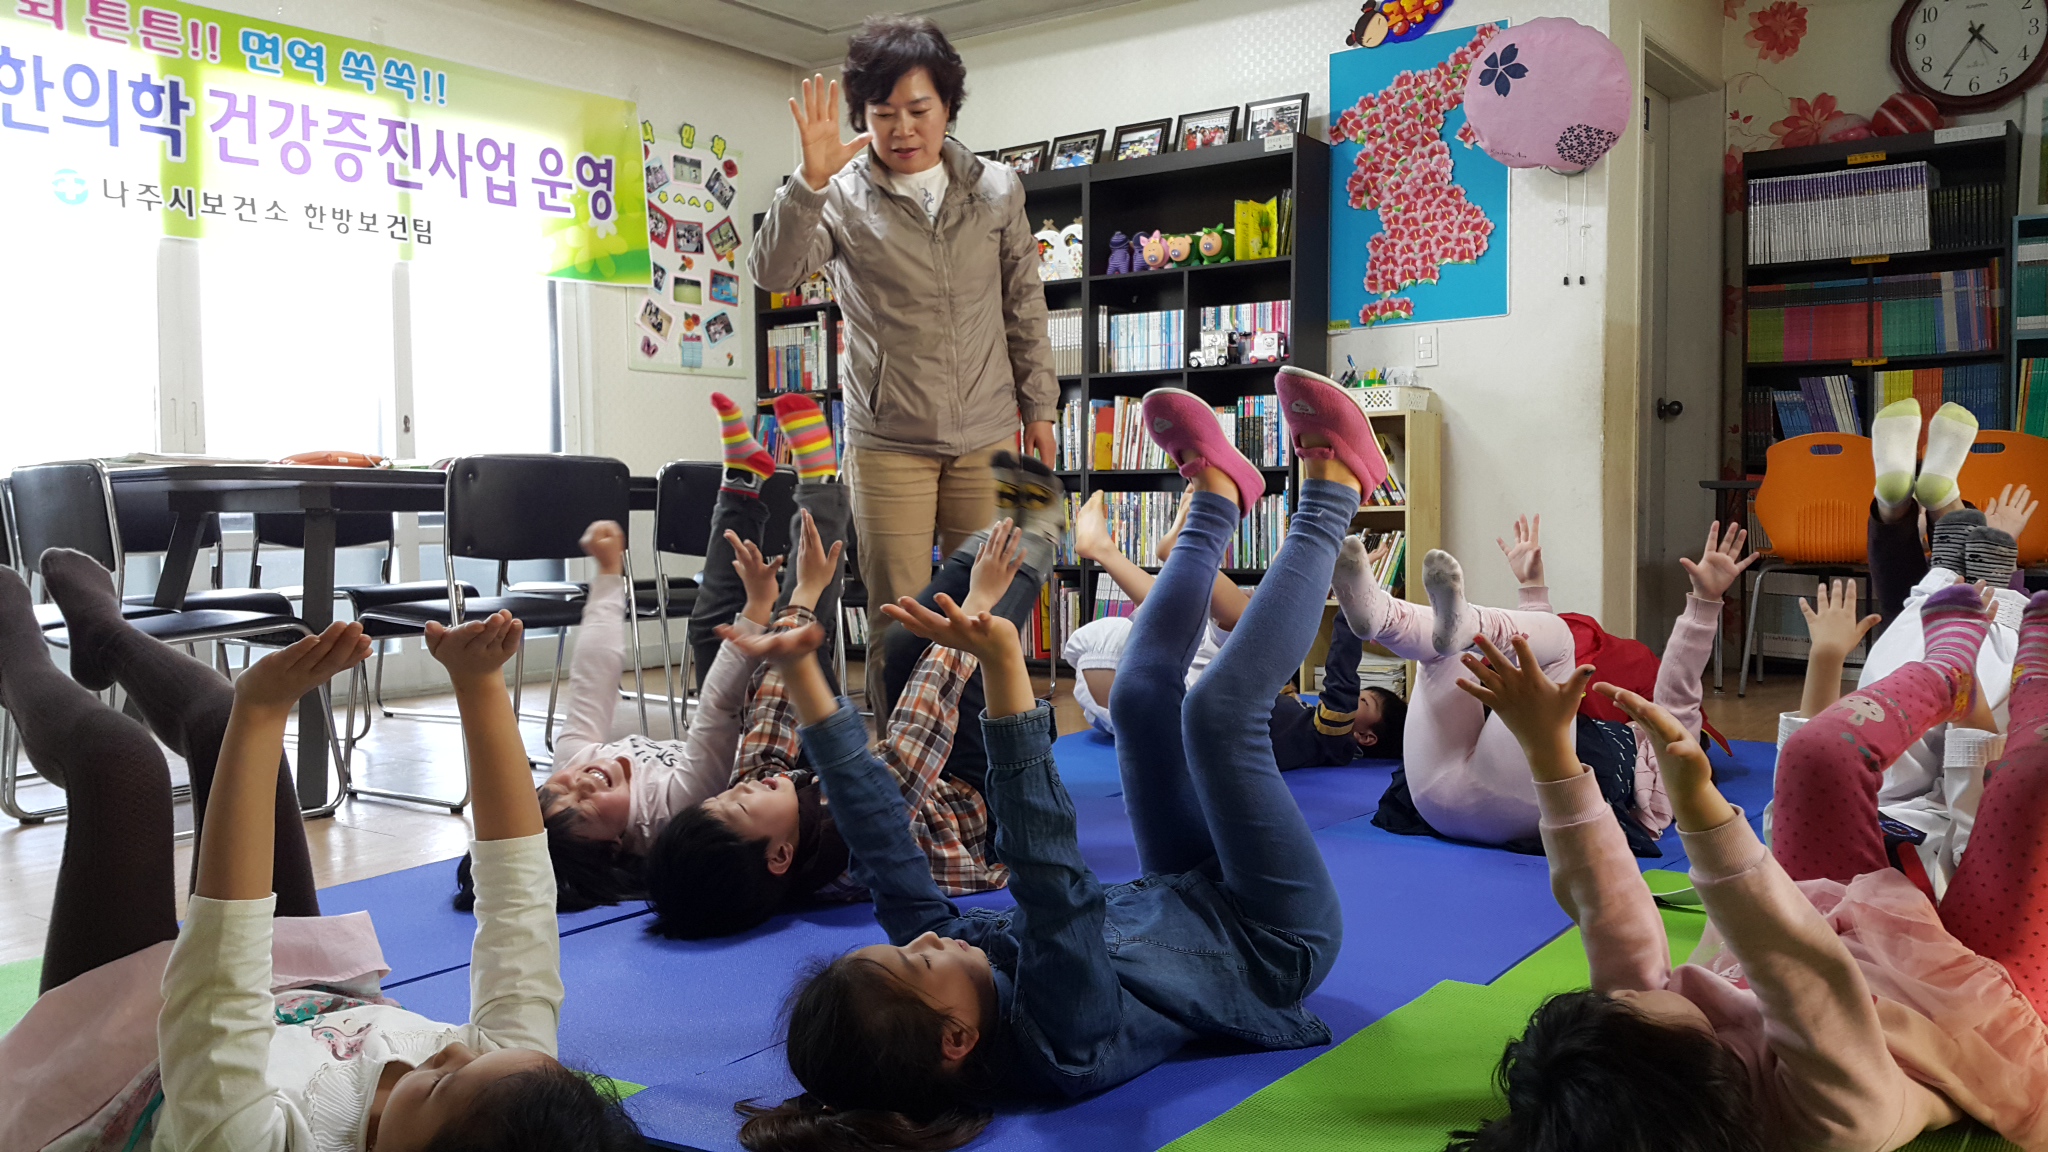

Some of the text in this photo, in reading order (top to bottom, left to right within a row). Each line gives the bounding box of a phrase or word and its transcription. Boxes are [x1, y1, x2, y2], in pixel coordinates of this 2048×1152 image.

[1921, 6, 1939, 24] 10
[2028, 17, 2040, 36] 3
[1915, 33, 1927, 51] 9
[84, 0, 220, 61] 튼튼!!
[241, 30, 325, 83] 면역
[341, 50, 446, 105] 쑥쑥!!
[2018, 44, 2030, 61] 4
[1921, 56, 1933, 73] 8
[1943, 73, 1954, 91] 7
[1968, 75, 1980, 93] 6
[1996, 66, 2009, 84] 5
[0, 44, 614, 221] 한의학 건강증진사업 운영
[102, 178, 433, 246] 나주시보건소 한방보건팀
